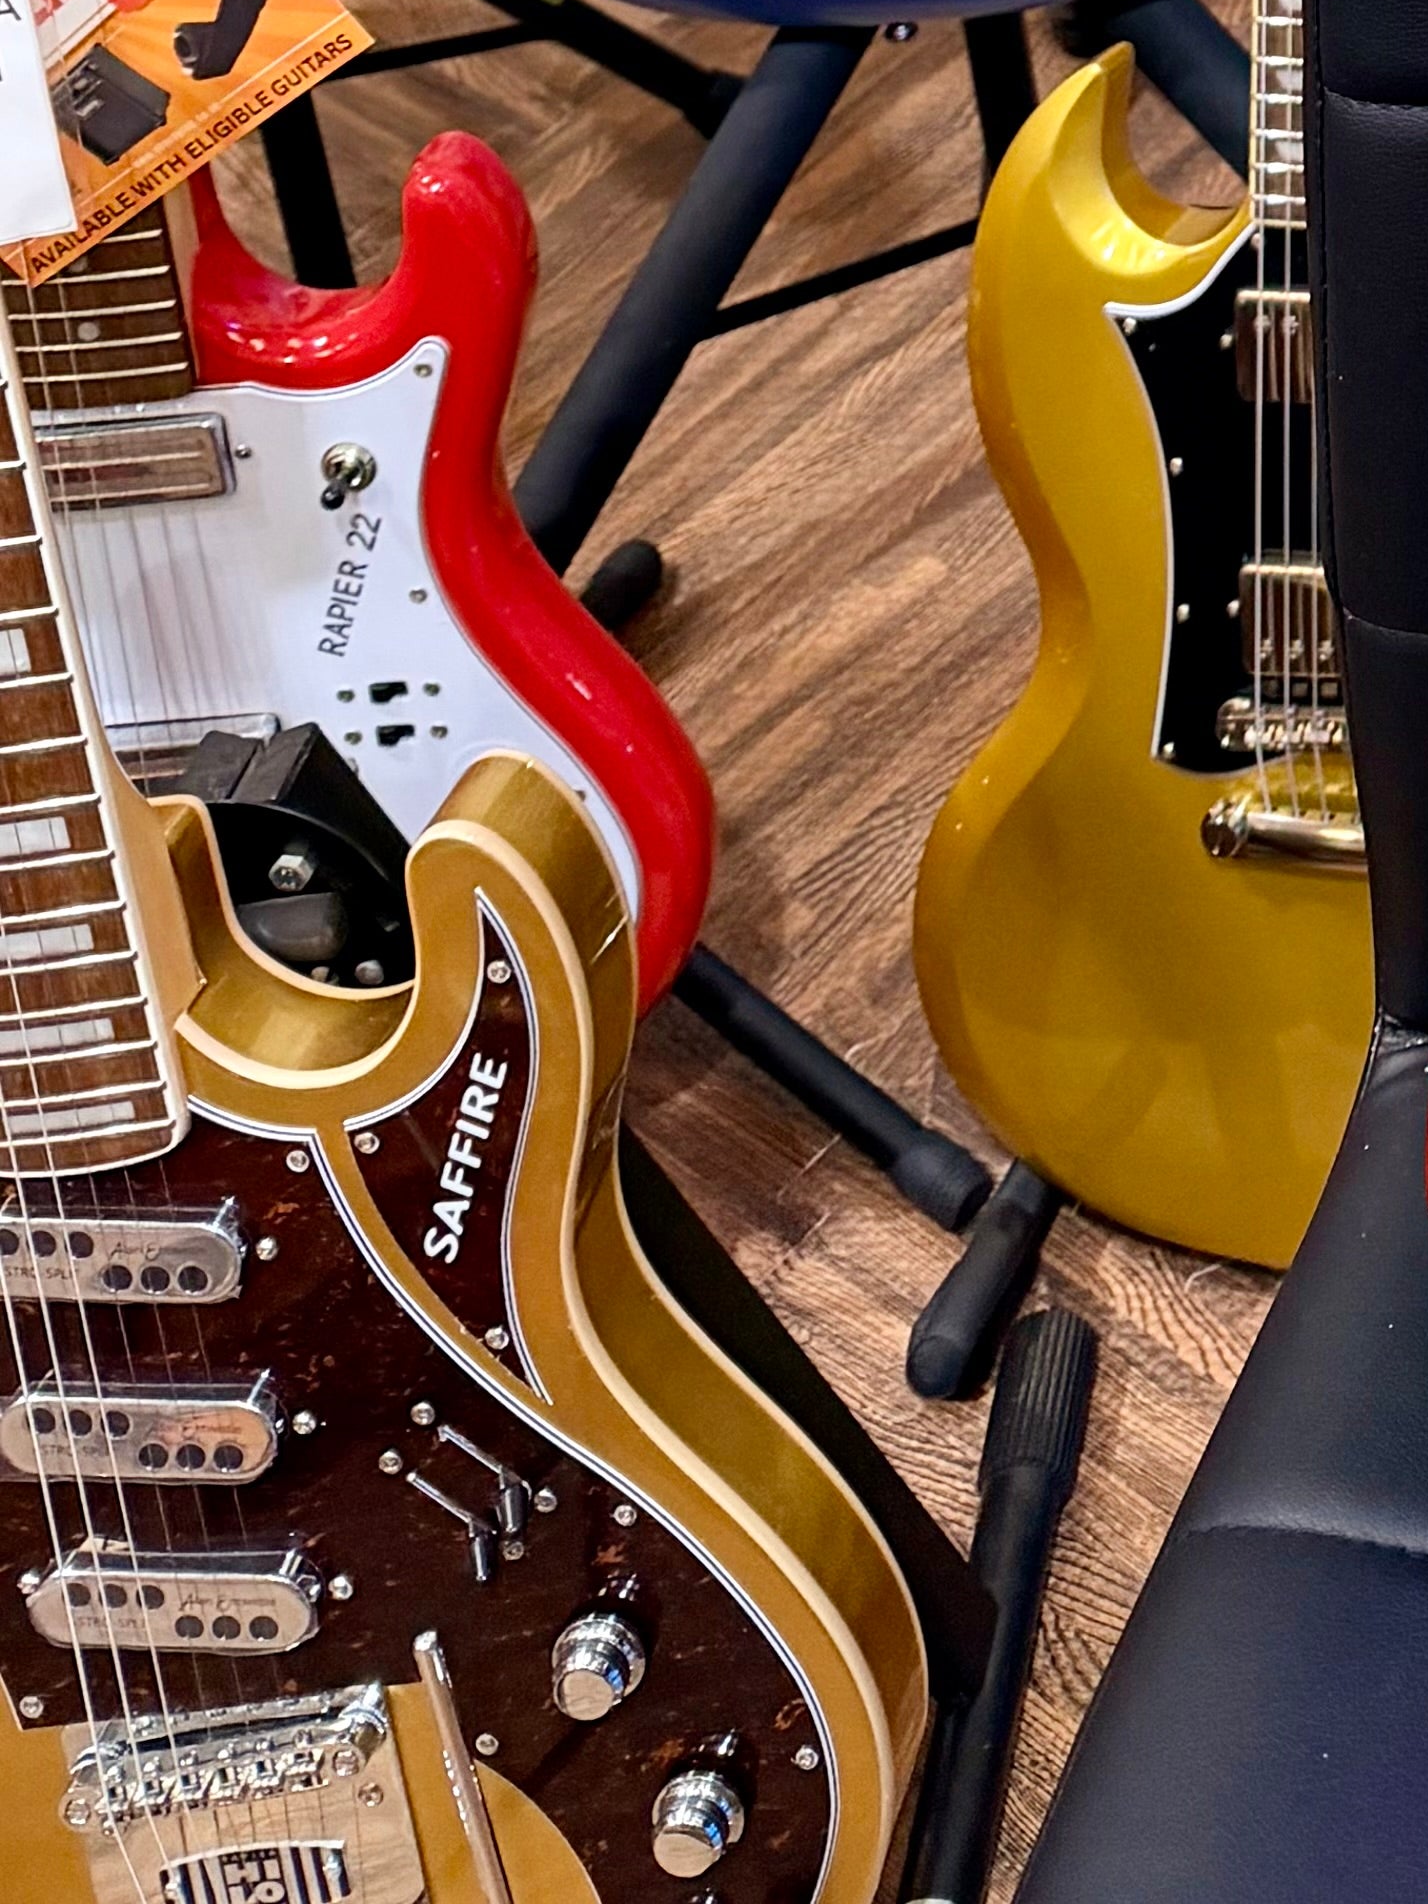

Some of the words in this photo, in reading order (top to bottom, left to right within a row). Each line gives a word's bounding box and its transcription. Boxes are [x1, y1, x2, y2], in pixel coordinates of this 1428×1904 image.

[29, 191, 138, 275] AVAILABLE
[131, 154, 187, 198] WITH
[184, 90, 274, 161] ELIGIBLE
[269, 33, 354, 97] GUITARS
[317, 560, 369, 657] RAPIER
[346, 513, 382, 552] 22
[423, 1051, 508, 1264] SAFFIRE
